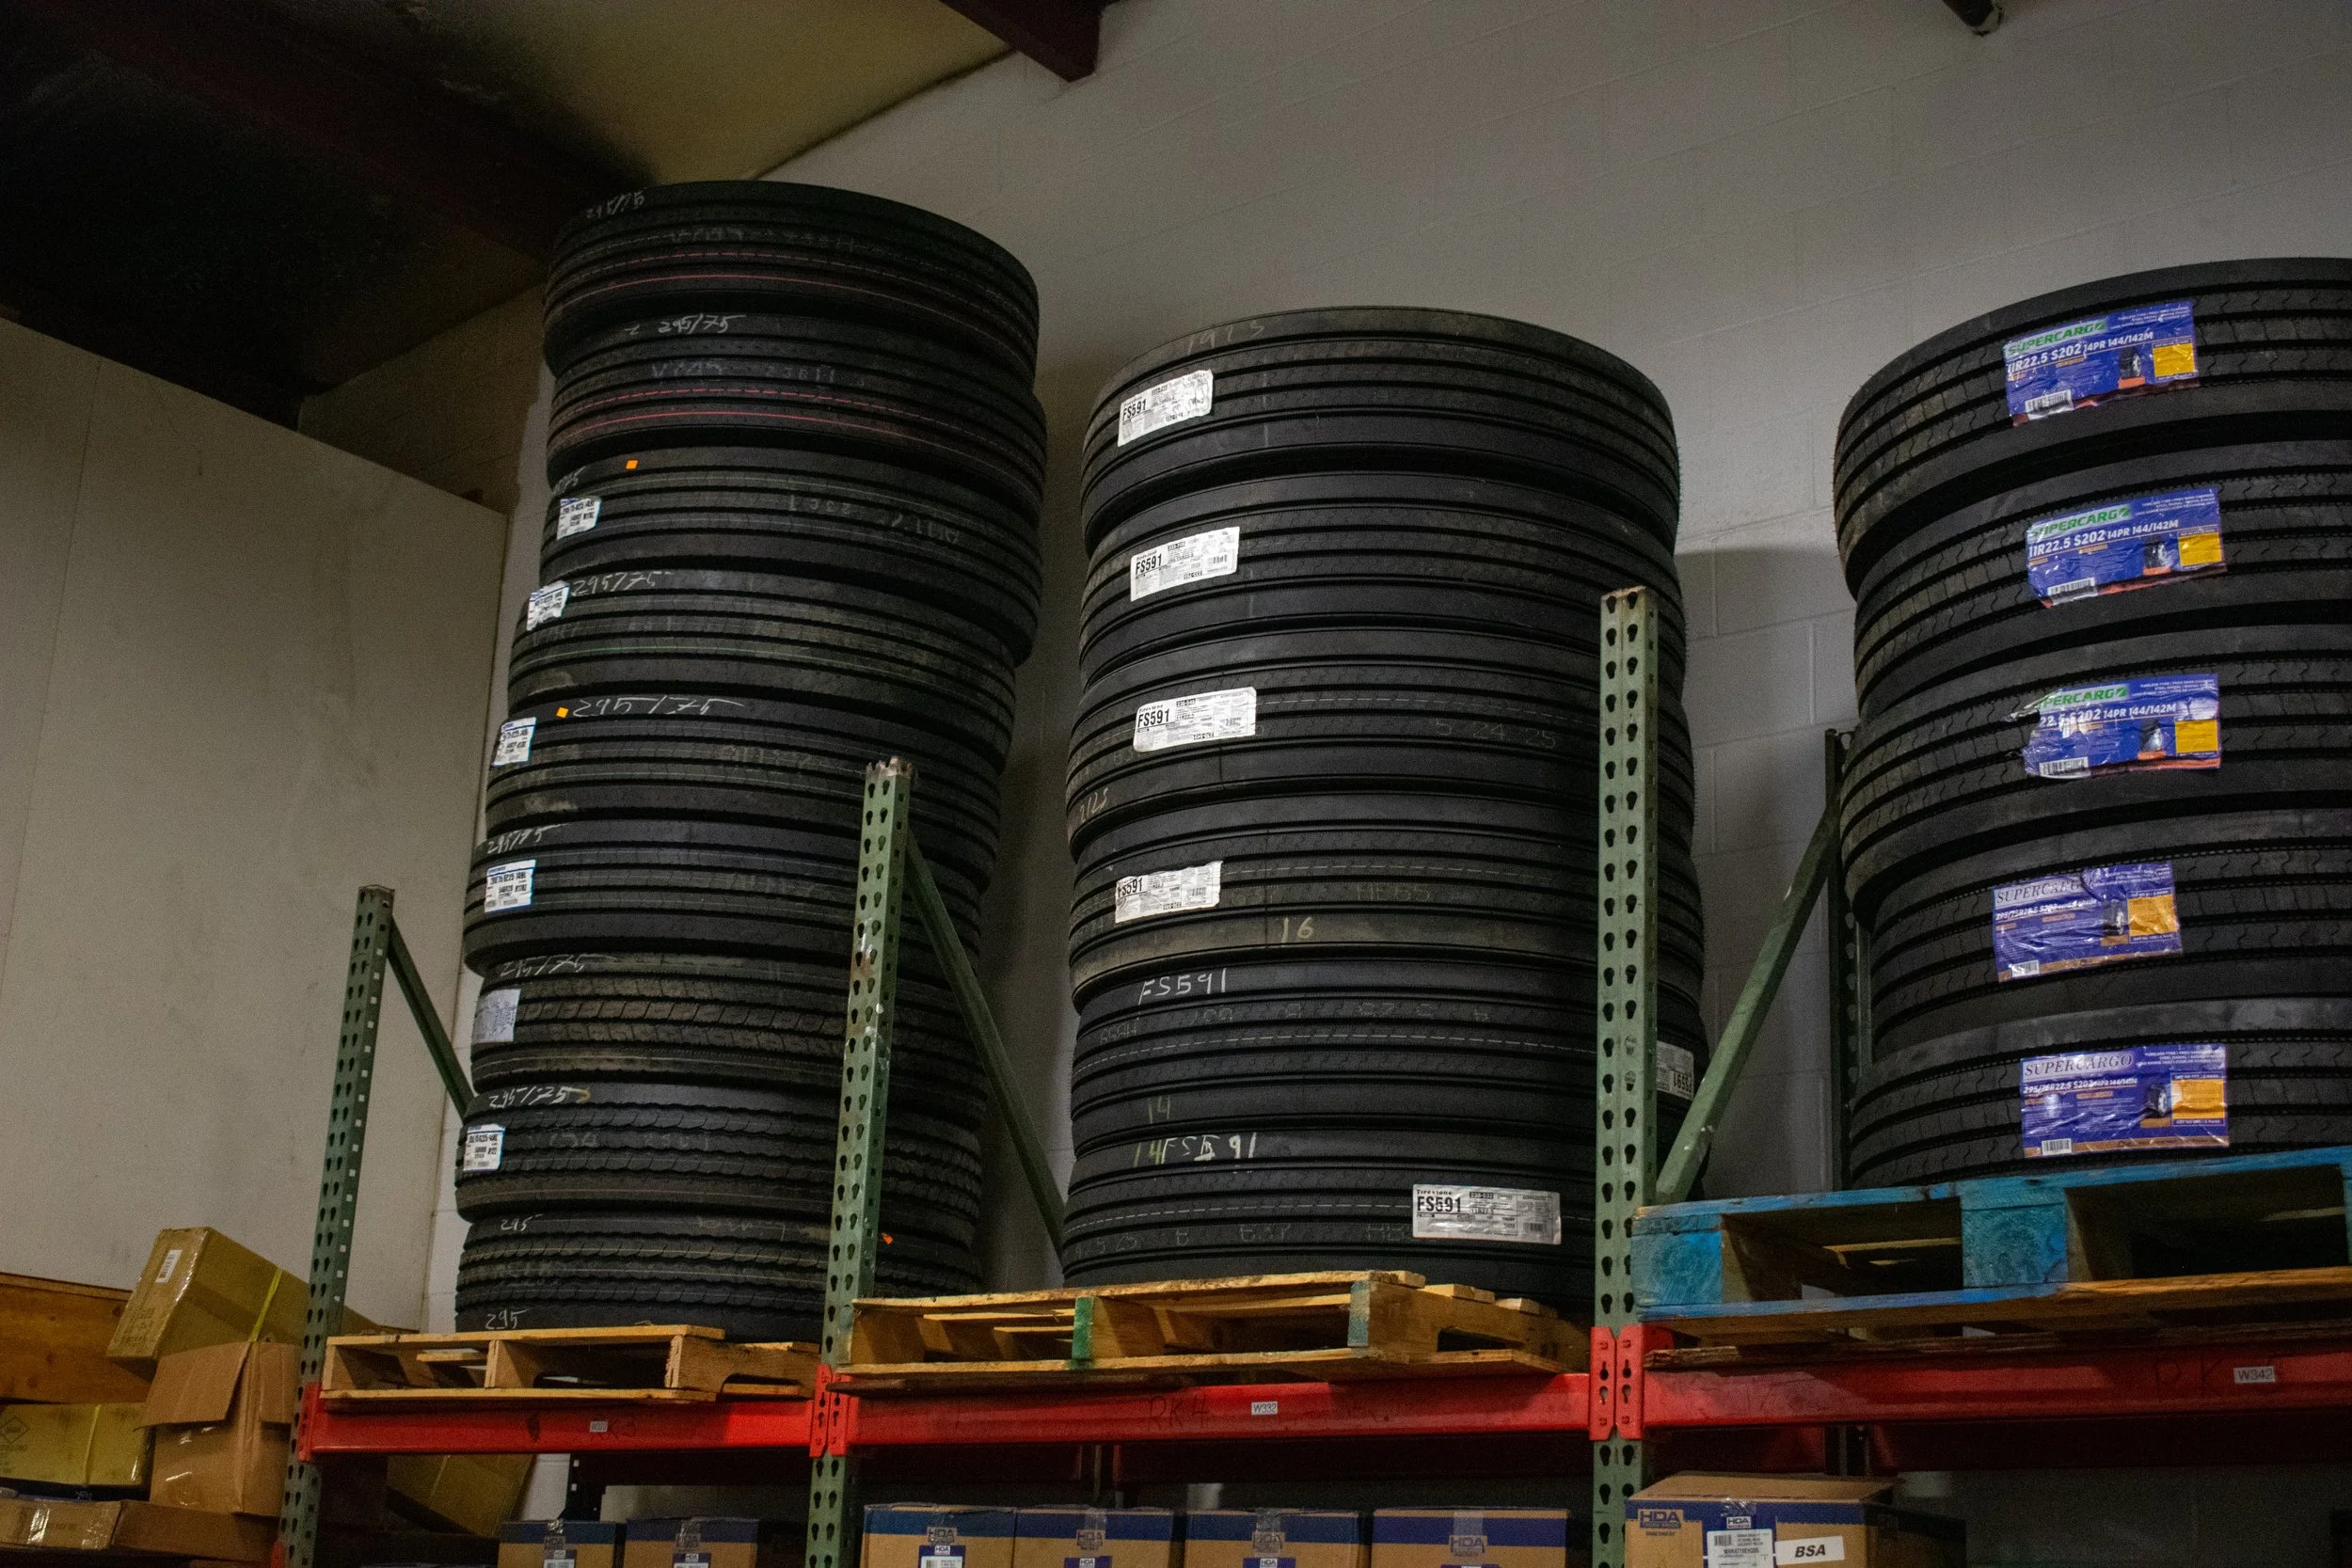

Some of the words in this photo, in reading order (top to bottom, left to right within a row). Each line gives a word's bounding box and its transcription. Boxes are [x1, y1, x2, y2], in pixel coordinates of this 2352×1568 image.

[2008, 321, 2106, 356] SUPERCARGO
[2051, 342, 2082, 361] S202
[2107, 331, 2153, 350] 144/142M
[1122, 399, 1147, 421] FS591
[2028, 537, 2071, 559] 11R22.5
[2074, 530, 2106, 547] S202
[2107, 526, 2130, 540] 14PR
[2132, 519, 2179, 535] 144/142M
[1136, 553, 1163, 575] FS591
[1137, 708, 1170, 728] FS591
[2103, 706, 2126, 720] 14PR
[2129, 704, 2176, 717] 144/142M
[1117, 877, 1143, 898] FS591
[1280, 916, 1312, 944] 16
[1137, 968, 1225, 1006] FS591
[2025, 1053, 2133, 1077] SUPERCARGO
[1416, 1196, 1462, 1212] FS591
[484, 1307, 532, 1330] 295
[2236, 1368, 2274, 1382] W342
[1253, 1402, 1277, 1414] W332
[1639, 1510, 1679, 1522] HDA
[1794, 1544, 1827, 1559] BSA
